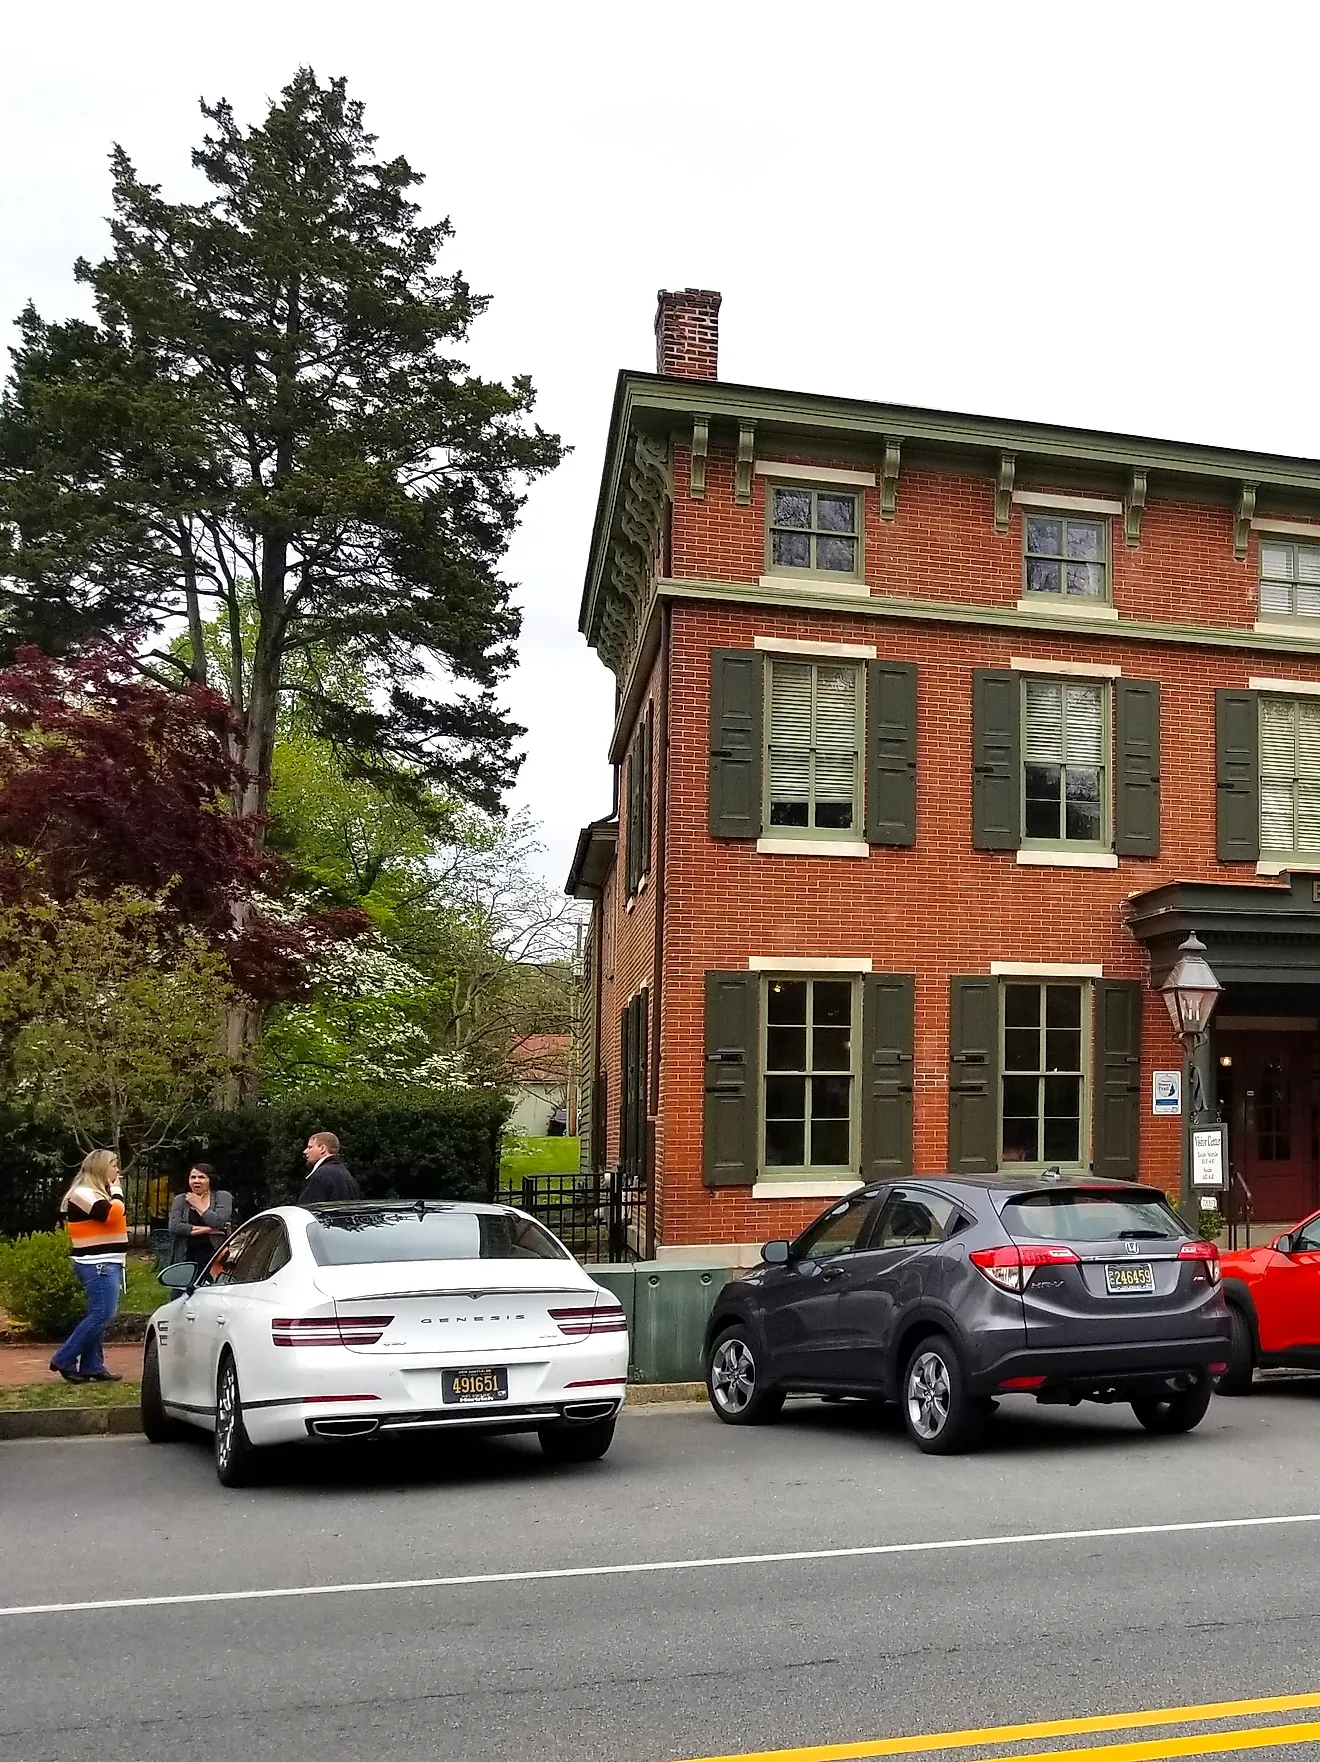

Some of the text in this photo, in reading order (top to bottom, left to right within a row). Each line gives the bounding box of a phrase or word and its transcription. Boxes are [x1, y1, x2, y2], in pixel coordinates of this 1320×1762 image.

[1114, 1269, 1151, 1285] 246459
[420, 1314, 526, 1324] GENESIS
[452, 1375, 499, 1394] 491651
